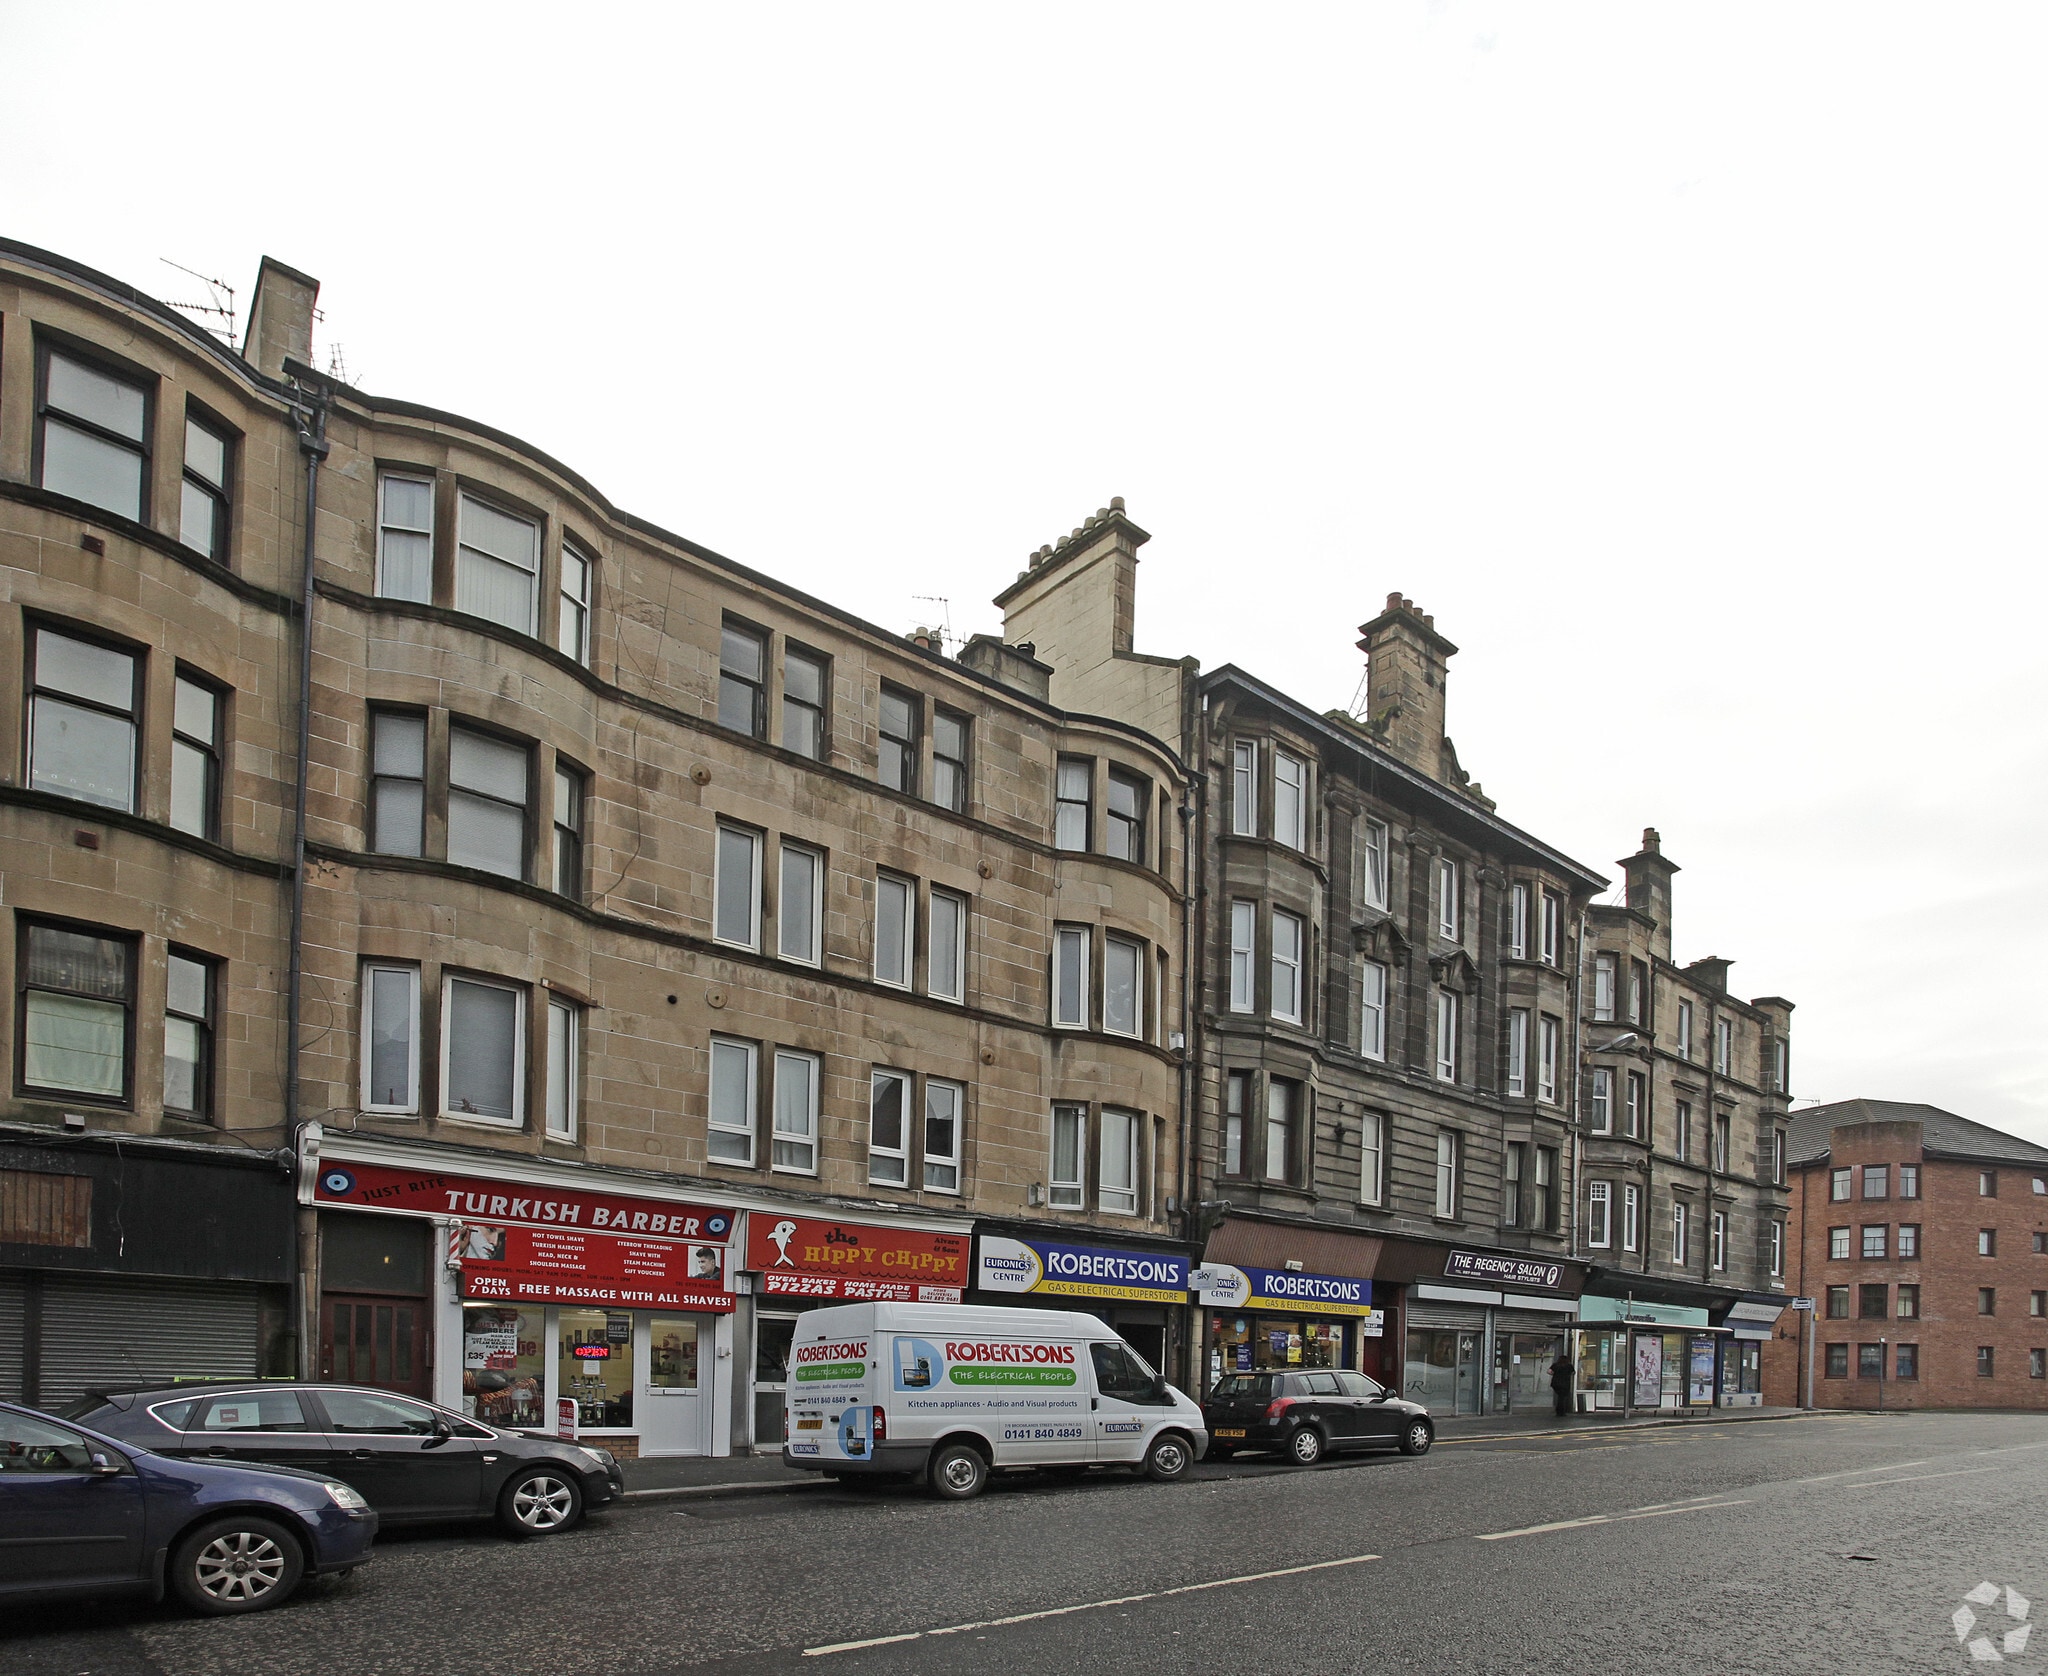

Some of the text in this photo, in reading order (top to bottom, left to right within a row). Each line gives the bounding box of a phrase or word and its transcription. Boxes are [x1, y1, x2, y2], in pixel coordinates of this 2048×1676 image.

[362, 1177, 446, 1201] JUST RITE
[445, 1190, 700, 1236] TURKISH BARBER
[545, 1233, 565, 1241] TOWEL
[824, 1228, 858, 1245] the
[617, 1241, 672, 1251] EYEBROW THREADING
[530, 1260, 560, 1268] SHOULDER
[642, 1260, 666, 1268] MACHINE
[804, 1246, 959, 1272] HIPPY CHIPPY
[986, 1259, 1030, 1270] EURONICS
[1048, 1252, 1178, 1283] ROBERTSONS
[1455, 1255, 1546, 1277] THE REGENCY SALON
[638, 1269, 665, 1277] VOUCHERS
[993, 1272, 1025, 1282] CENTRE
[1197, 1272, 1211, 1280] sky
[474, 1277, 506, 1286] OPEN
[801, 1277, 836, 1285] BAKED
[470, 1285, 510, 1296] 7 DAYS
[768, 1281, 836, 1294] PIZZAS
[844, 1287, 894, 1298] PASTA
[1048, 1283, 1178, 1300] GAS & ELECTRICAL SUPERSTORE
[1265, 1275, 1360, 1300] ROBERTSONS
[519, 1284, 731, 1306] FREE MASSAGE WITH ALL SHAVES!
[1211, 1290, 1234, 1298] CENTRE
[1265, 1299, 1360, 1313] GAS & ELECTRICAL SUPERSTORE
[575, 1347, 608, 1356] OPEN
[797, 1342, 867, 1363] ROBERTSONS
[946, 1342, 1075, 1363] ROBERTSONS
[979, 1371, 1035, 1380] ELECTRICAL
[940, 1401, 980, 1409] appliances
[1049, 1400, 1077, 1409] products
[1005, 1428, 1082, 1439] 0141 840 4849
[1107, 1424, 1140, 1432] EURONICS
[794, 1445, 817, 1453] EURONICS
